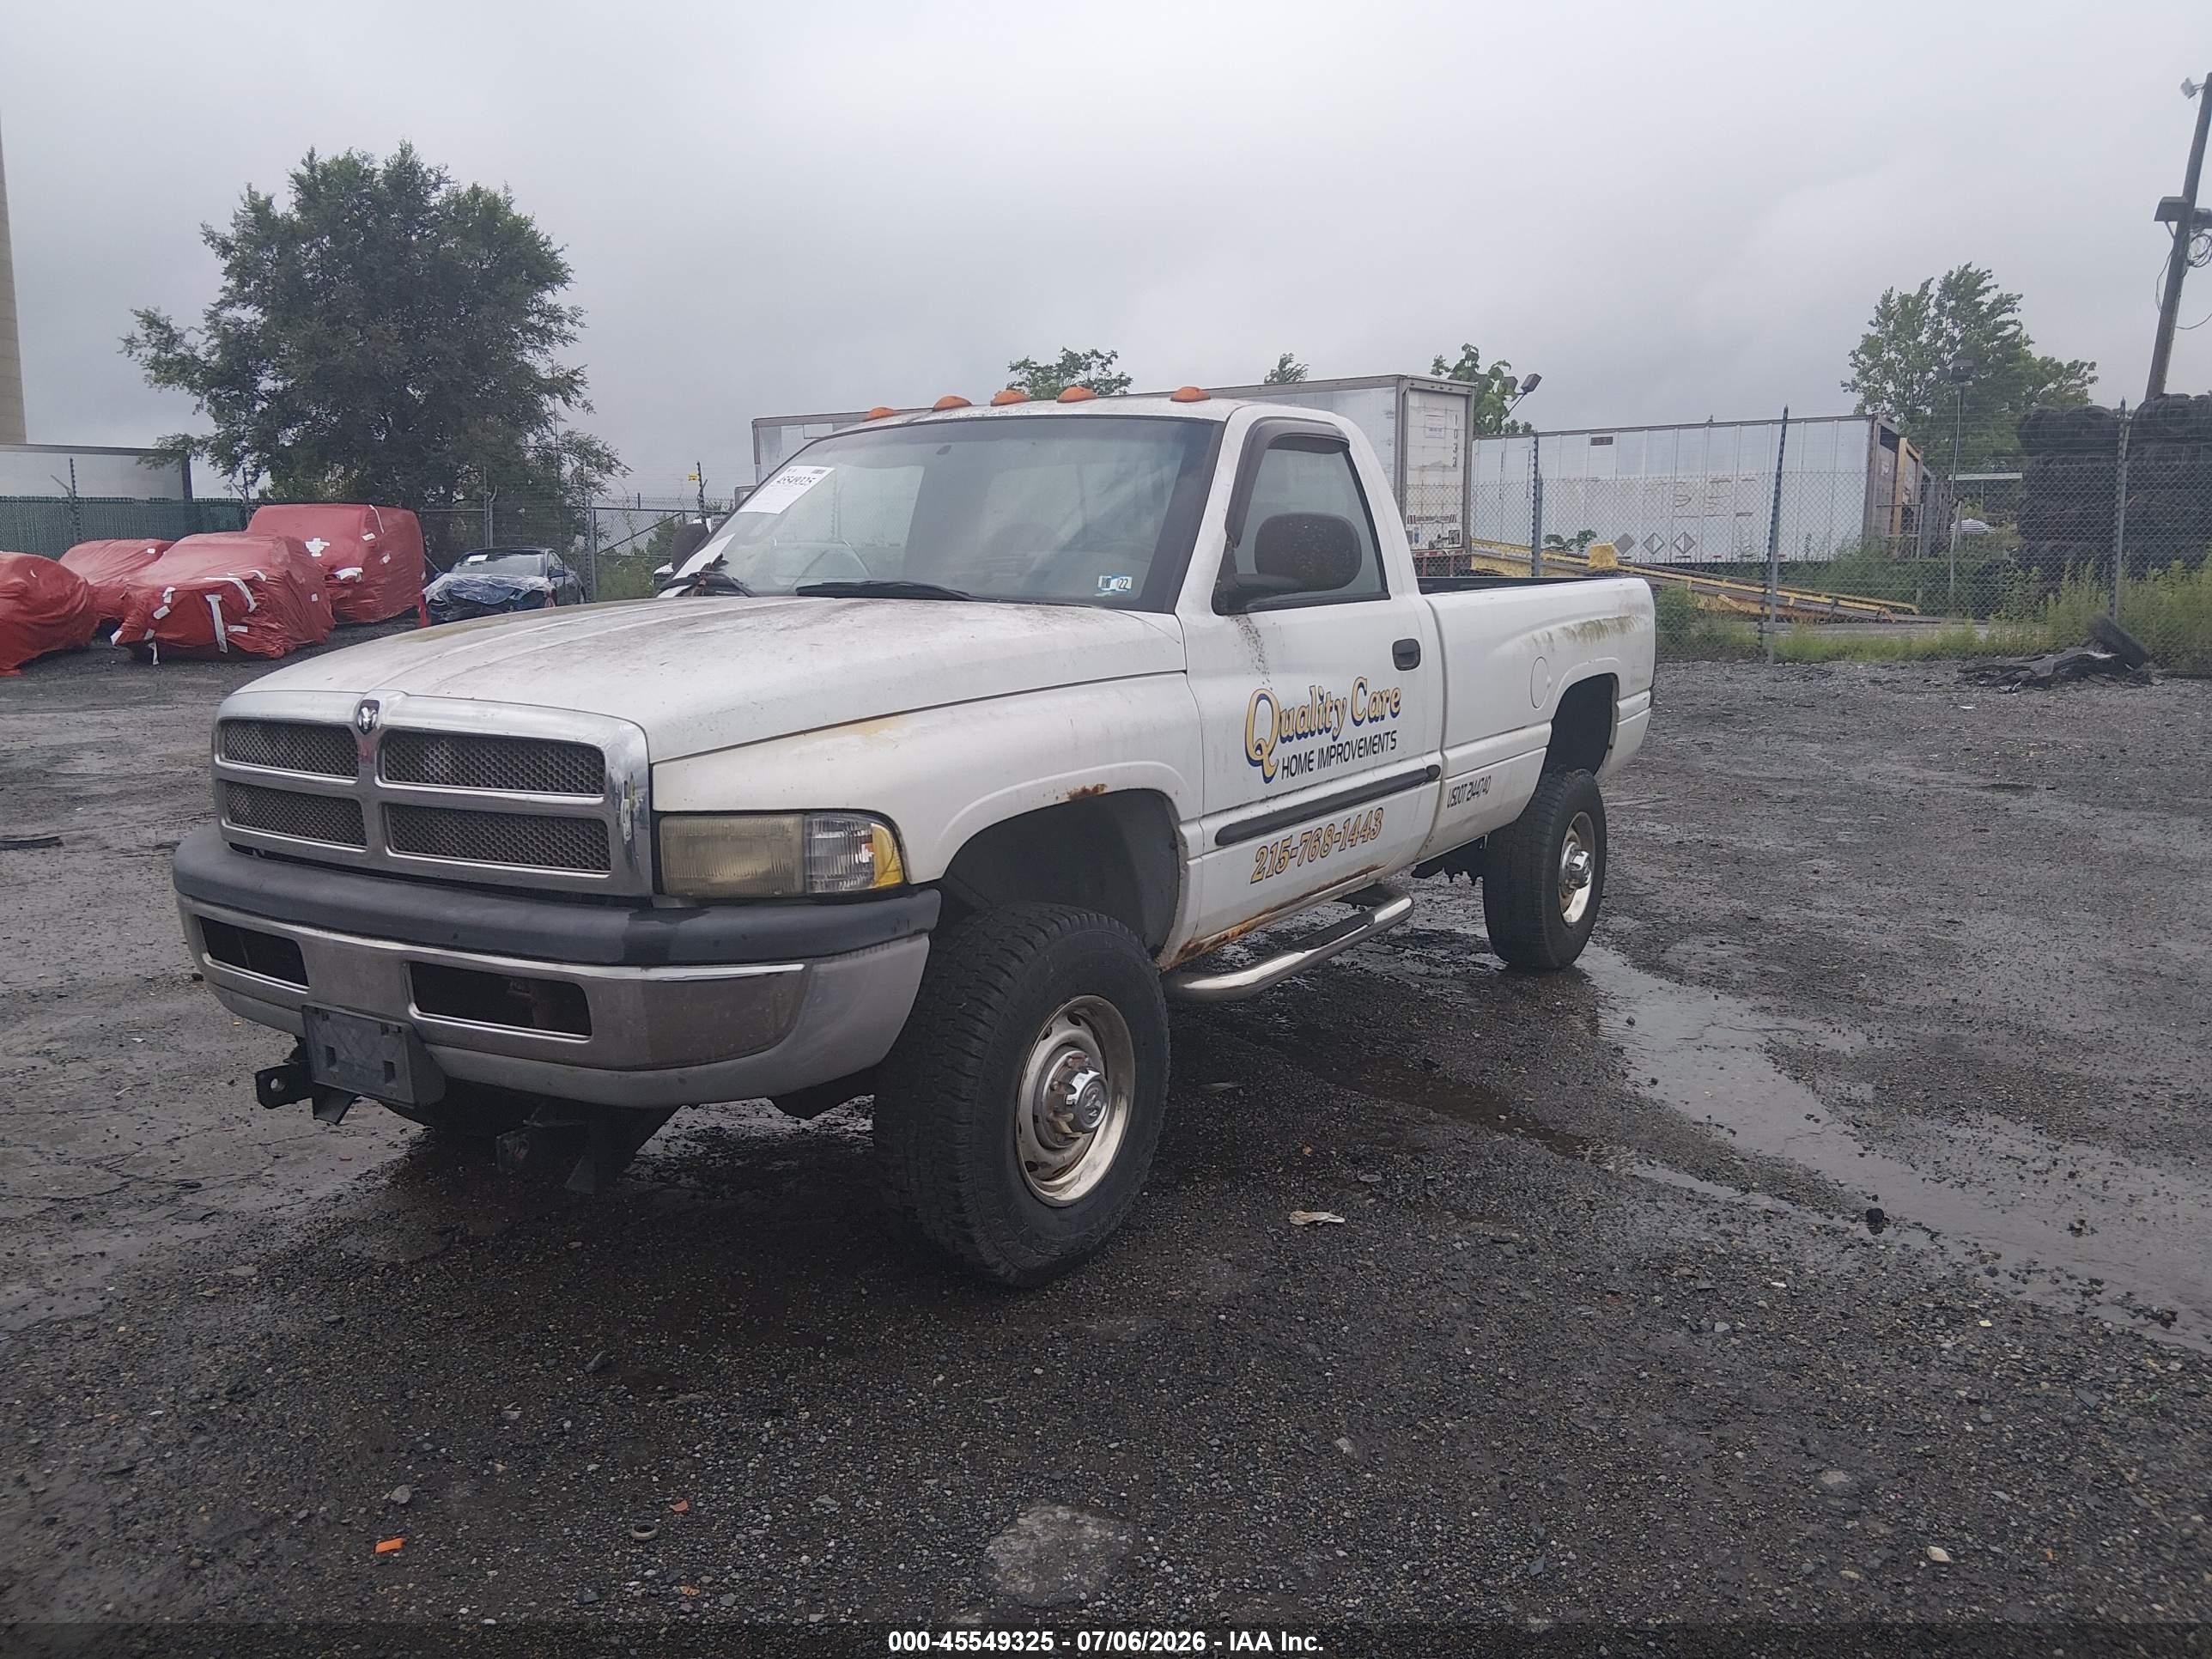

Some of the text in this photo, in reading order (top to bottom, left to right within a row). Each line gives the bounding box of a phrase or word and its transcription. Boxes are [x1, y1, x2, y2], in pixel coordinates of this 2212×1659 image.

[1118, 578, 1128, 590] 22
[1244, 676, 1401, 784] Quality Care
[1281, 729, 1398, 780] HOME IMPROVEMENTS
[1249, 806, 1384, 885] 215-768-1443
